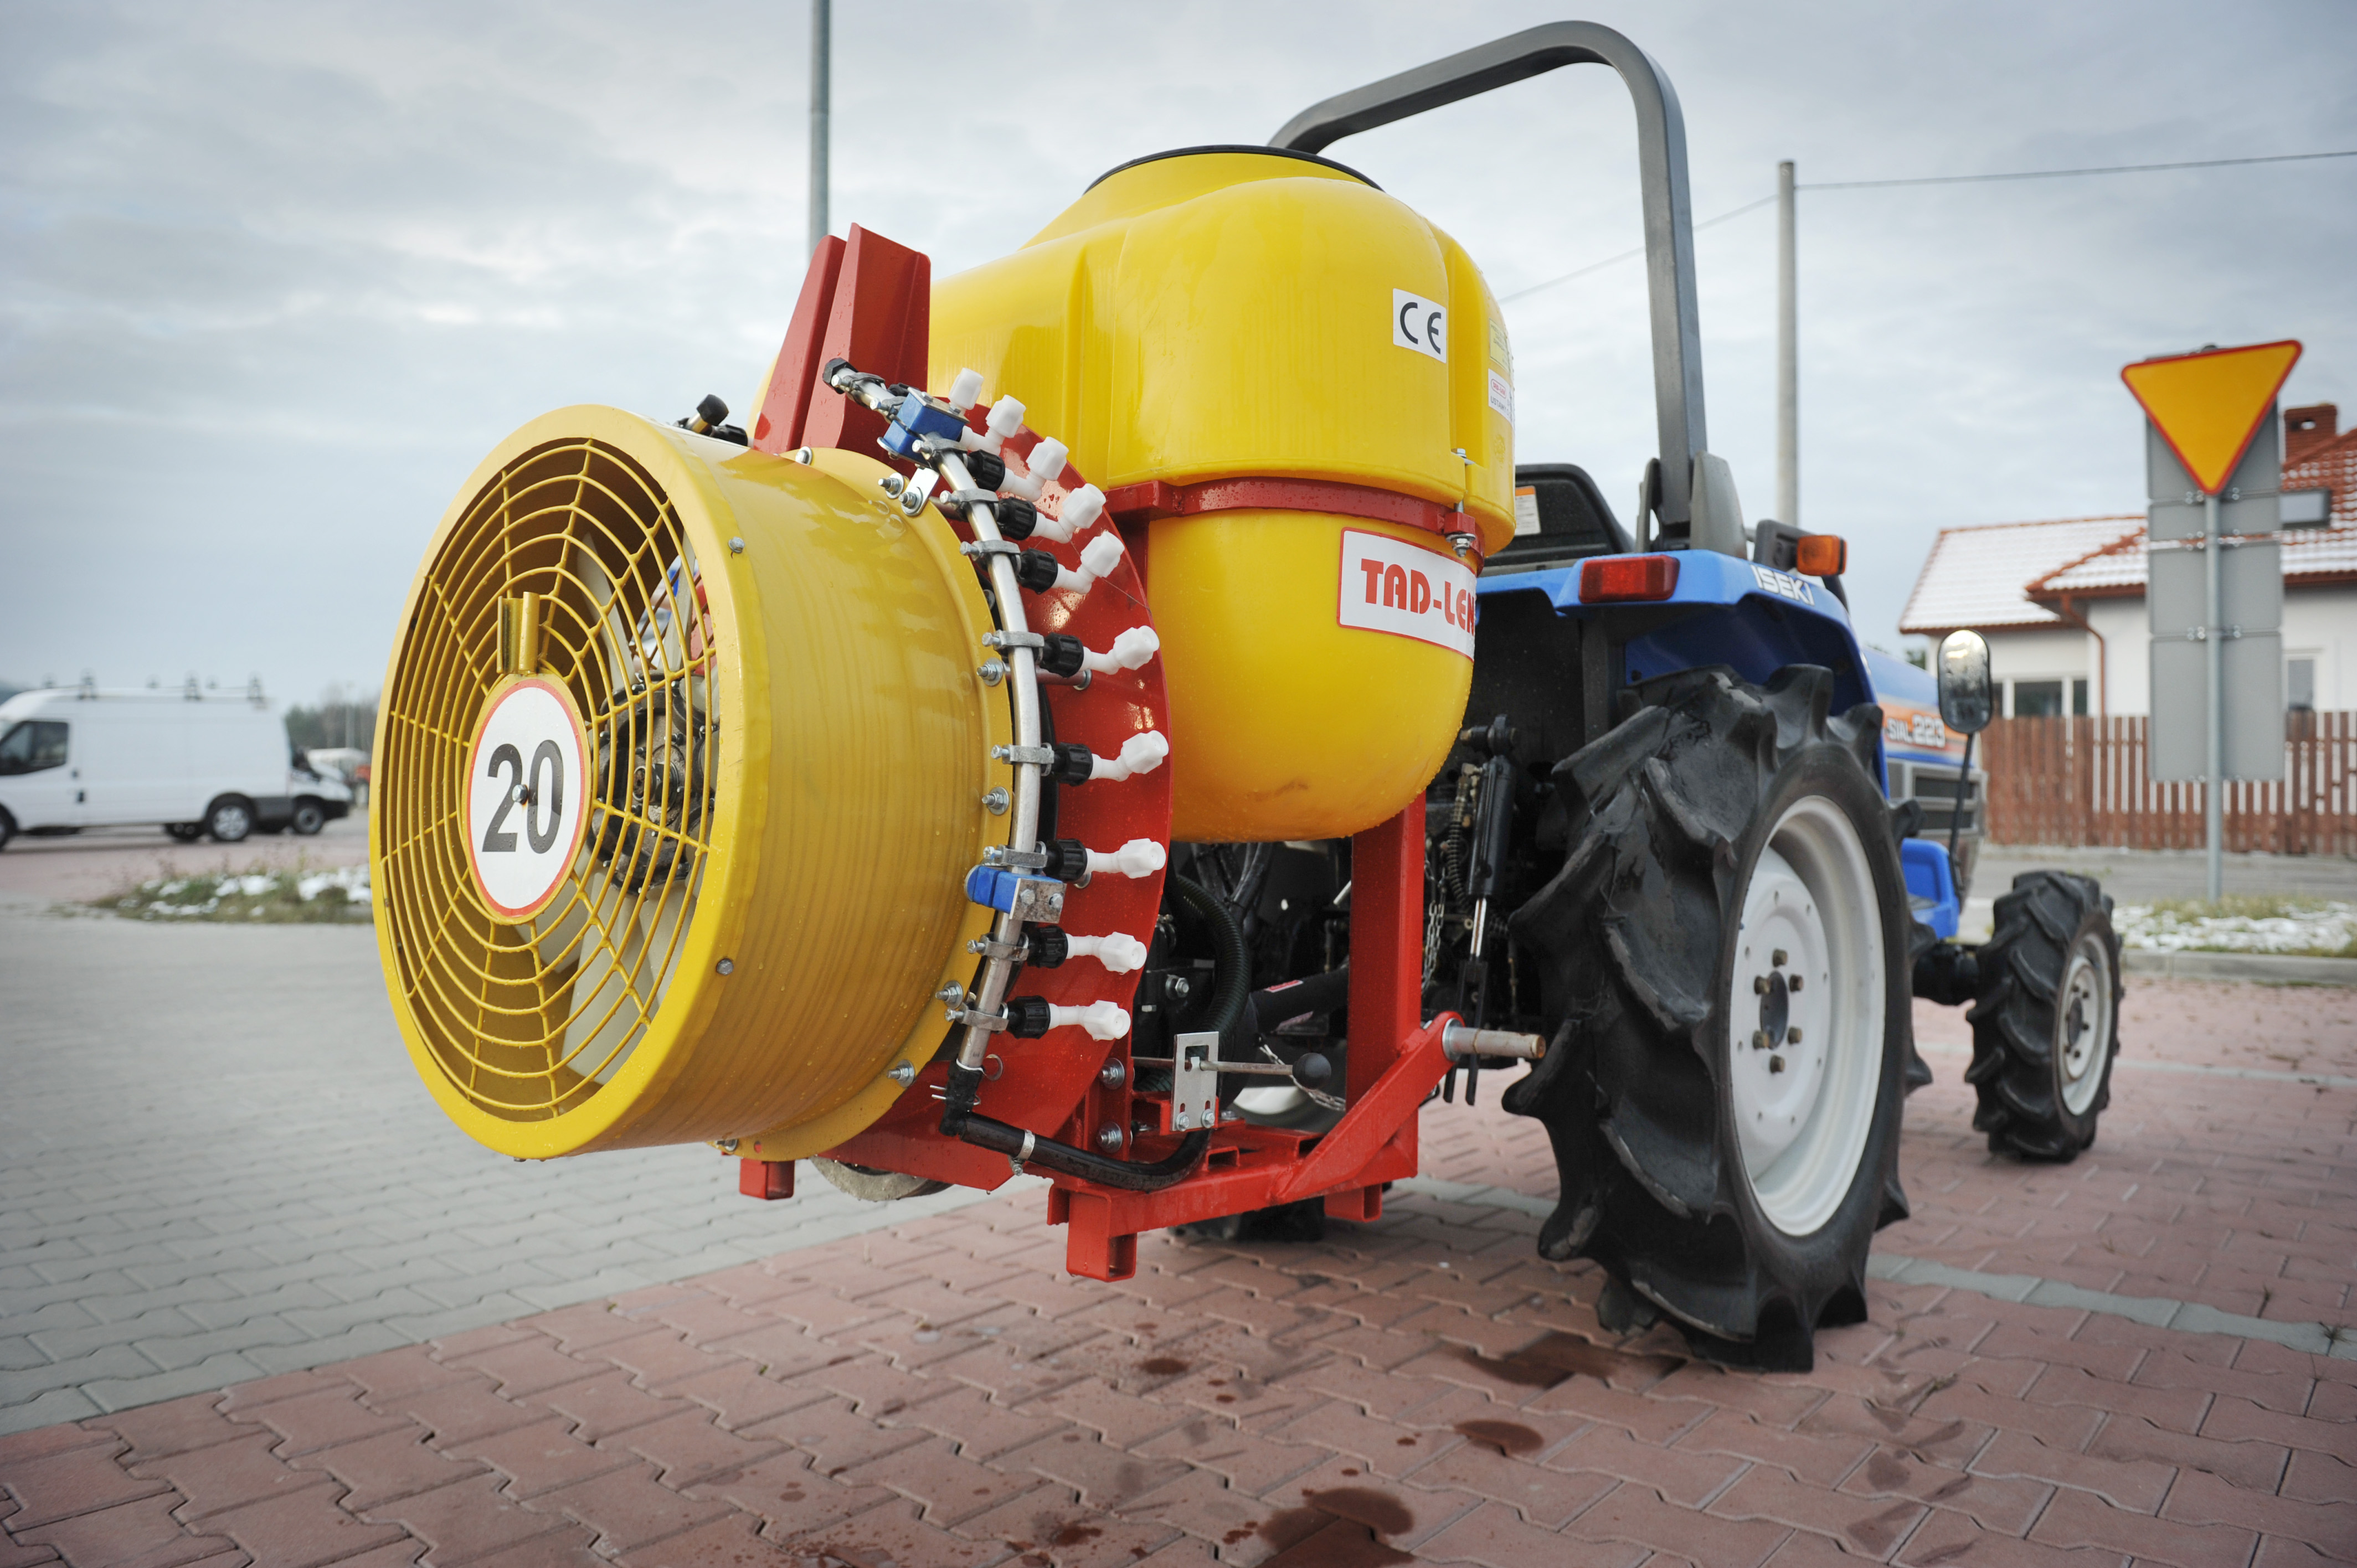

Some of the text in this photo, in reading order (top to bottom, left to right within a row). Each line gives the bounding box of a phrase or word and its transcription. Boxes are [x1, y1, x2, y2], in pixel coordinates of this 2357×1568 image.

[1399, 302, 1442, 354] CE
[1361, 558, 1474, 636] TAD-LEN
[1750, 564, 1815, 606] ISEKI
[1887, 714, 1946, 749] SIAL 223
[482, 739, 564, 854] 20
